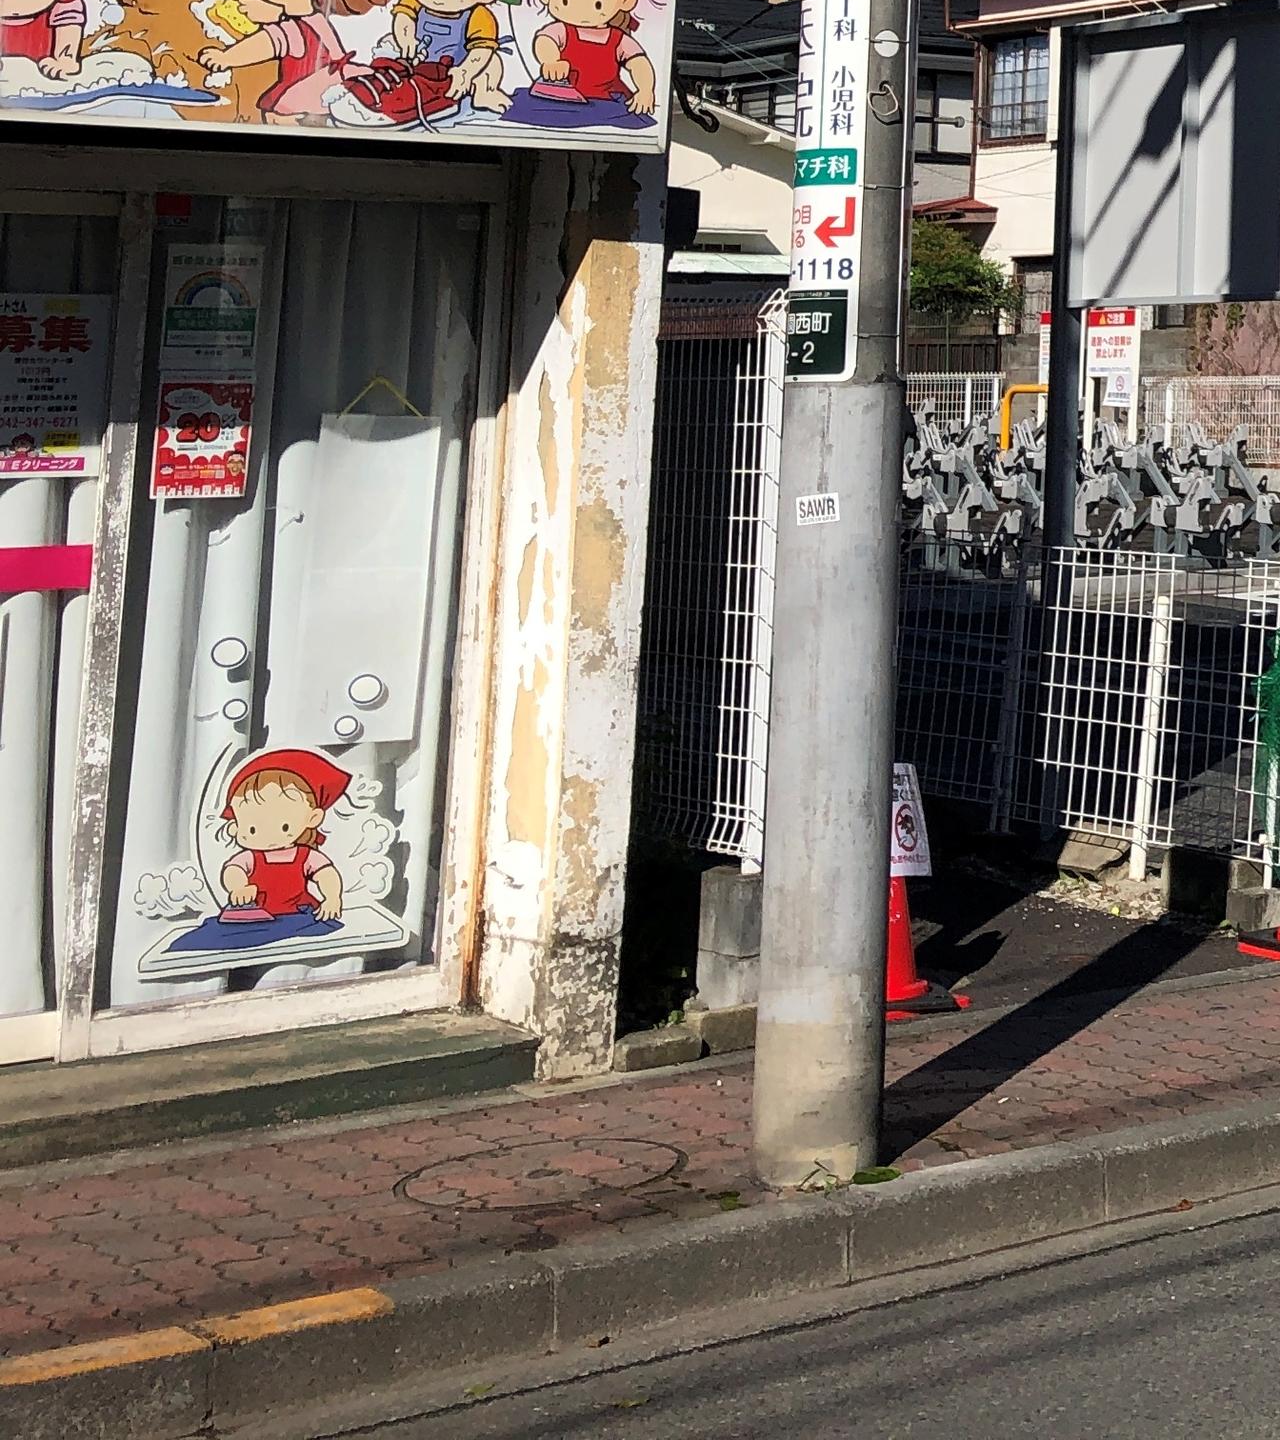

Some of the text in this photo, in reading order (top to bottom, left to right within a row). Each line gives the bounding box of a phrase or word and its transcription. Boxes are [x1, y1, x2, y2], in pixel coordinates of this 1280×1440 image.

[829, 65, 855, 136] 小児科
[799, 498, 836, 519] SAWR
